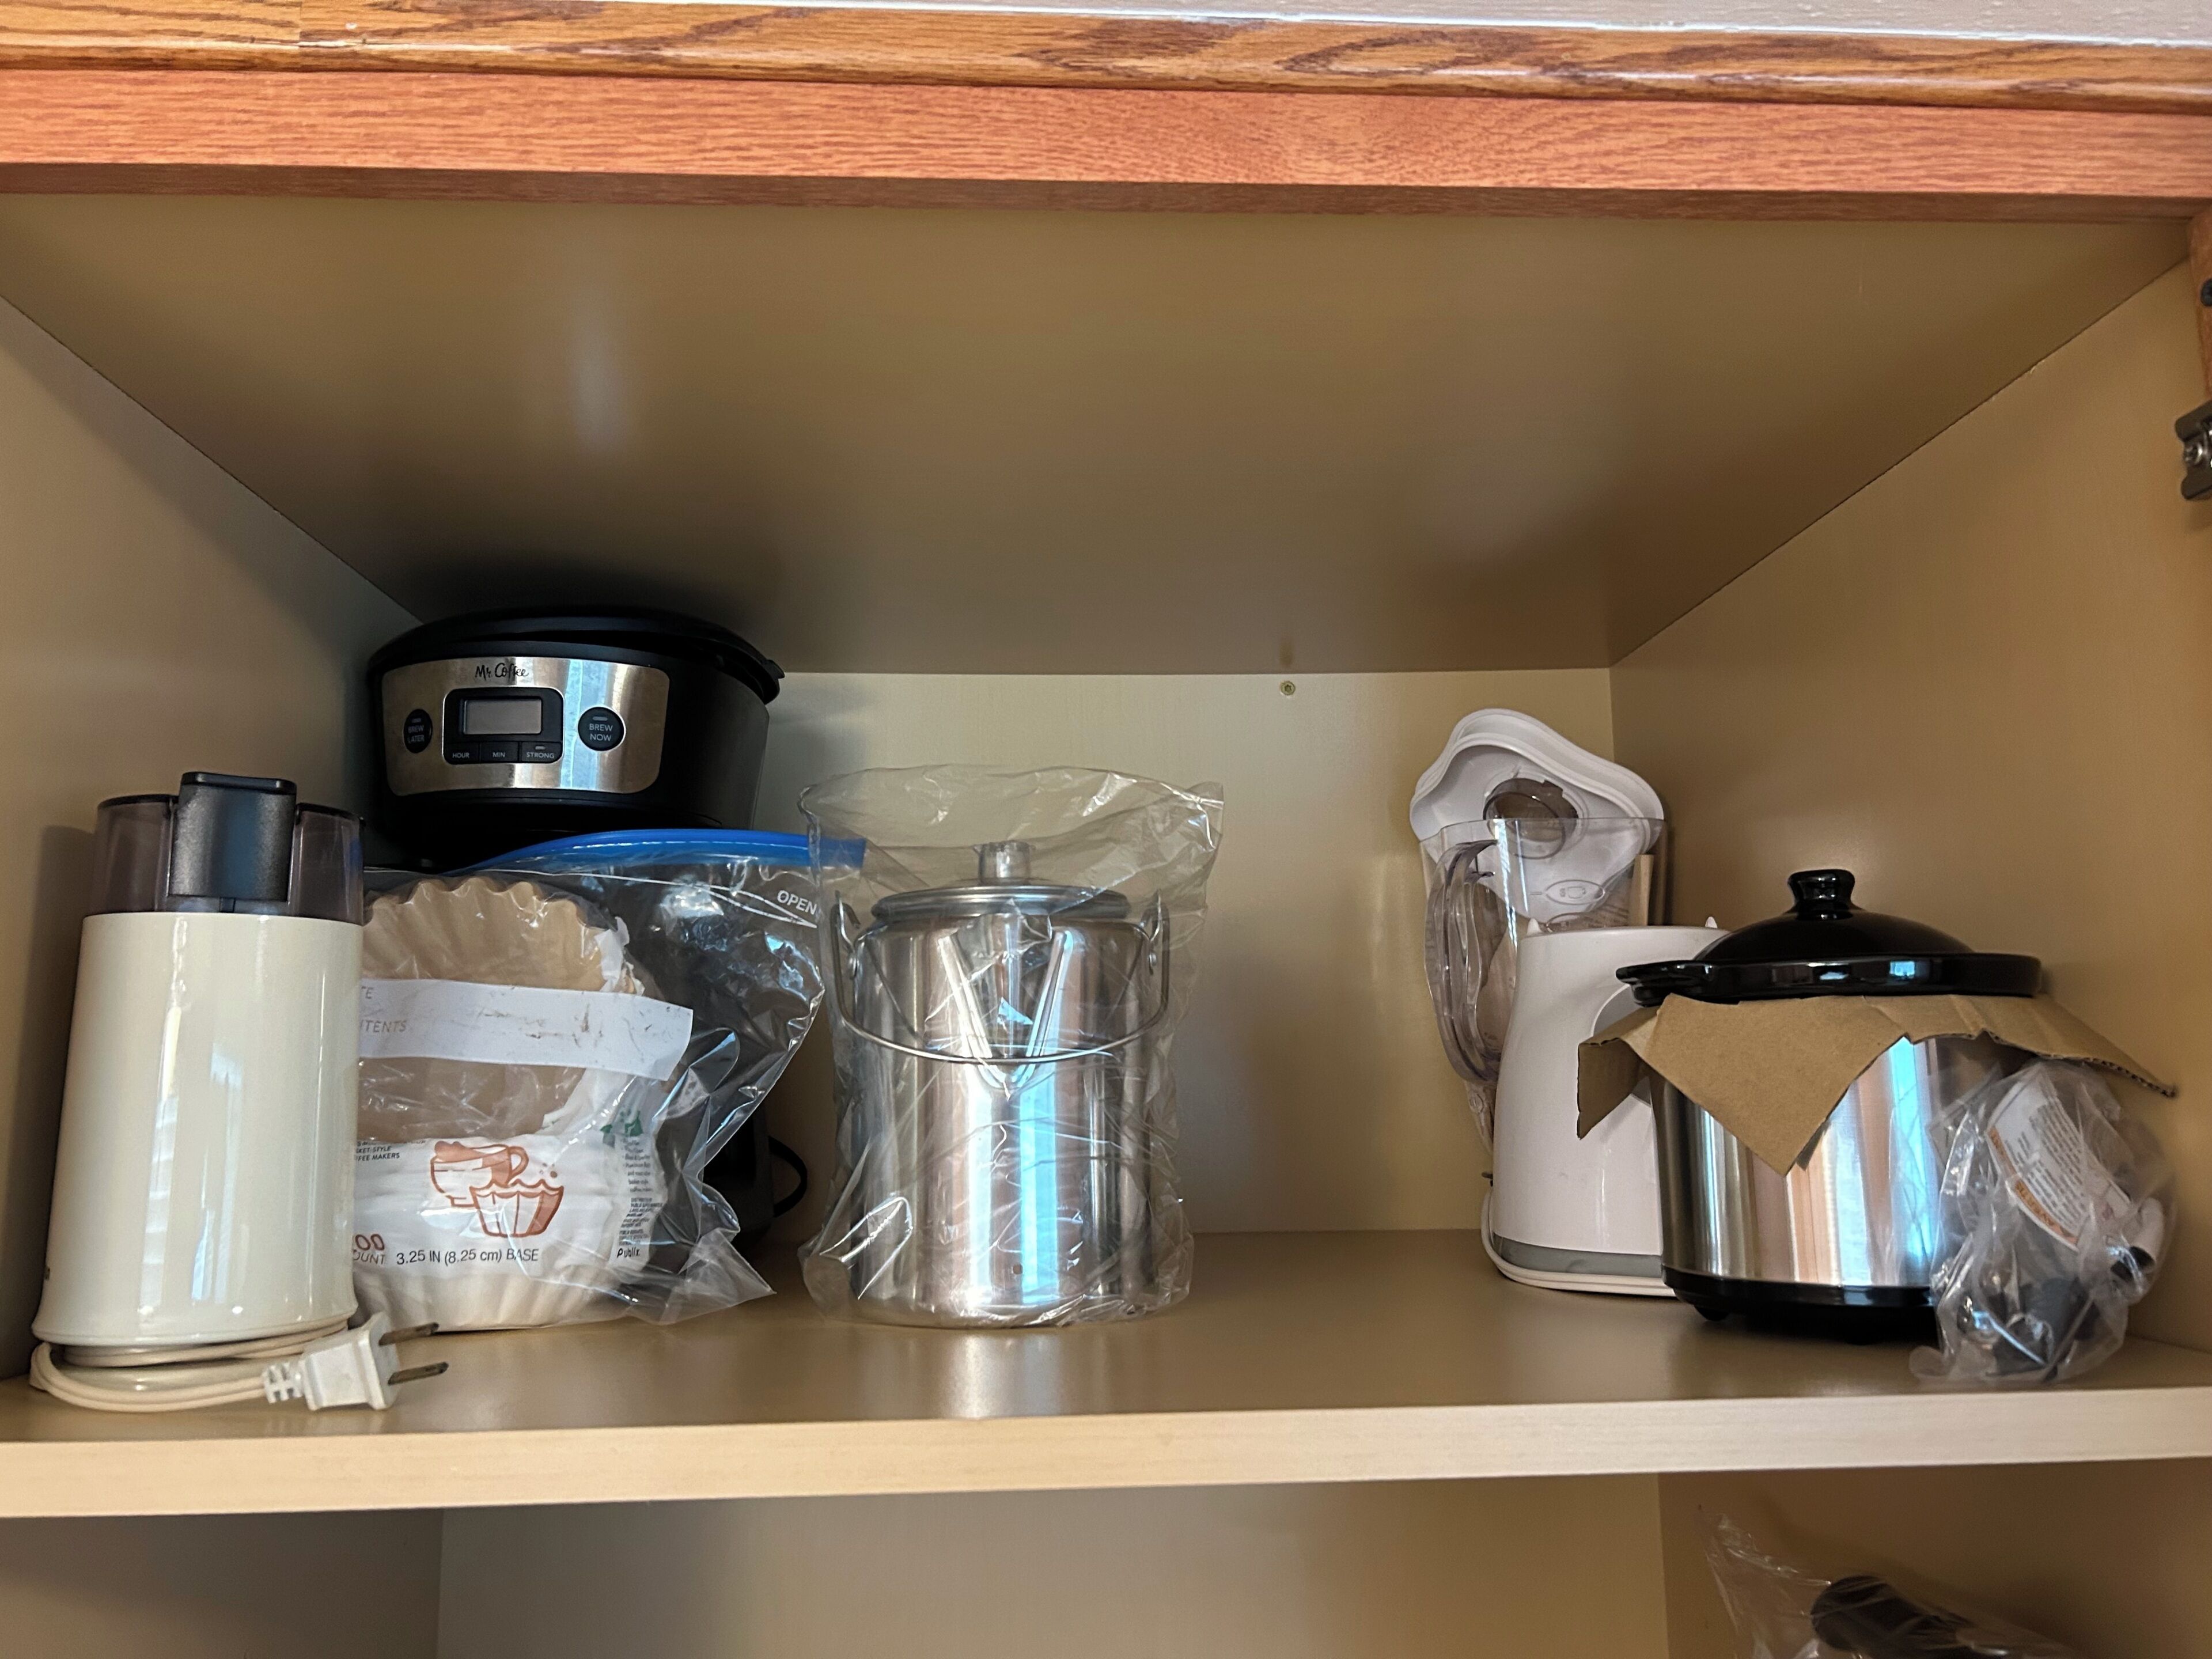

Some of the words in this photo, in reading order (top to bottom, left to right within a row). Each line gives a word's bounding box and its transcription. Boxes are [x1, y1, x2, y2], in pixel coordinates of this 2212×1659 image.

[495, 662, 529, 681] Coffee
[408, 725, 425, 733] BREW
[589, 723, 613, 732] BREW
[407, 734, 425, 743] LATER
[590, 733, 611, 741] NOW
[777, 890, 817, 915] OPEN
[396, 1249, 425, 1265] 3.25
[430, 1251, 440, 1263] IN
[445, 1248, 476, 1267] (8.25
[480, 1249, 502, 1263] cm)
[506, 1248, 539, 1262] BASE
[616, 1247, 640, 1258] Publix
